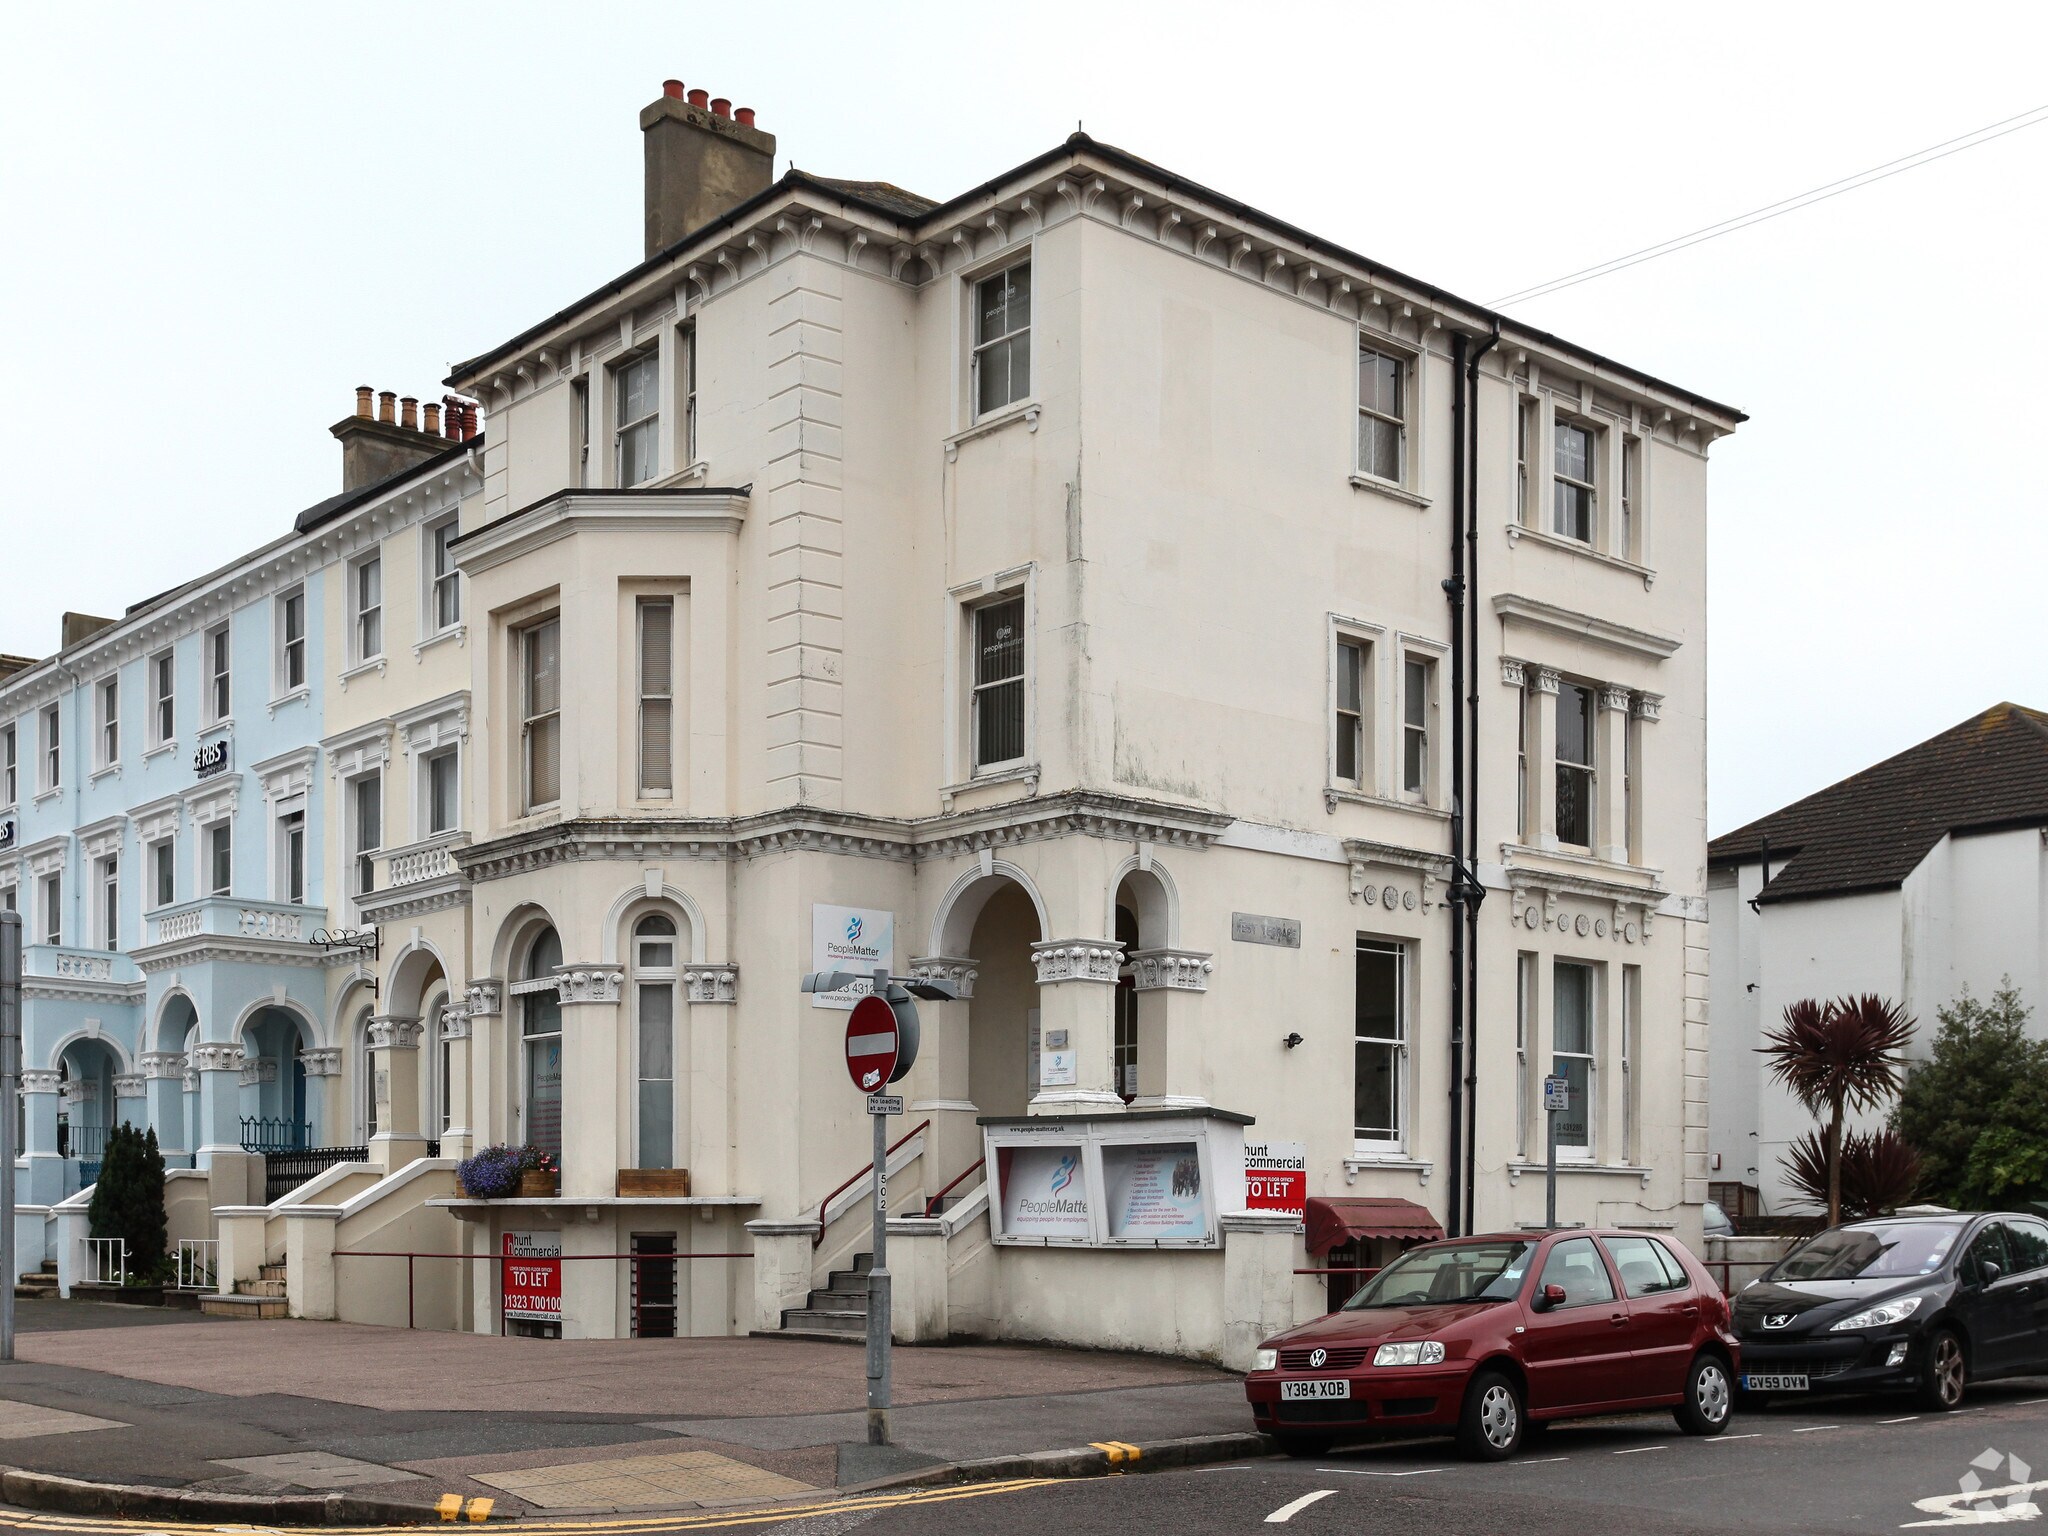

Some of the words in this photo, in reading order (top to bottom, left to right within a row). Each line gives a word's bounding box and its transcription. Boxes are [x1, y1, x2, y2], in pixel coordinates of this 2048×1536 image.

[202, 742, 223, 767] RBS
[828, 942, 879, 956] PeopleMatter
[1245, 1143, 1268, 1156] hunt
[1245, 1157, 1304, 1169] commercial
[1246, 1182, 1262, 1197] TO
[1267, 1183, 1289, 1197] LET
[1020, 1199, 1087, 1215] PeopleMatte
[514, 1234, 532, 1246] hunt
[514, 1245, 561, 1256] commercial
[514, 1272, 527, 1286] TO
[531, 1272, 548, 1287] LET
[530, 1296, 561, 1310] 700100
[1286, 1382, 1316, 1397] Y384
[1320, 1382, 1344, 1396] XOB
[1750, 1377, 1780, 1388] GV59
[1783, 1377, 1806, 1388] OVW
